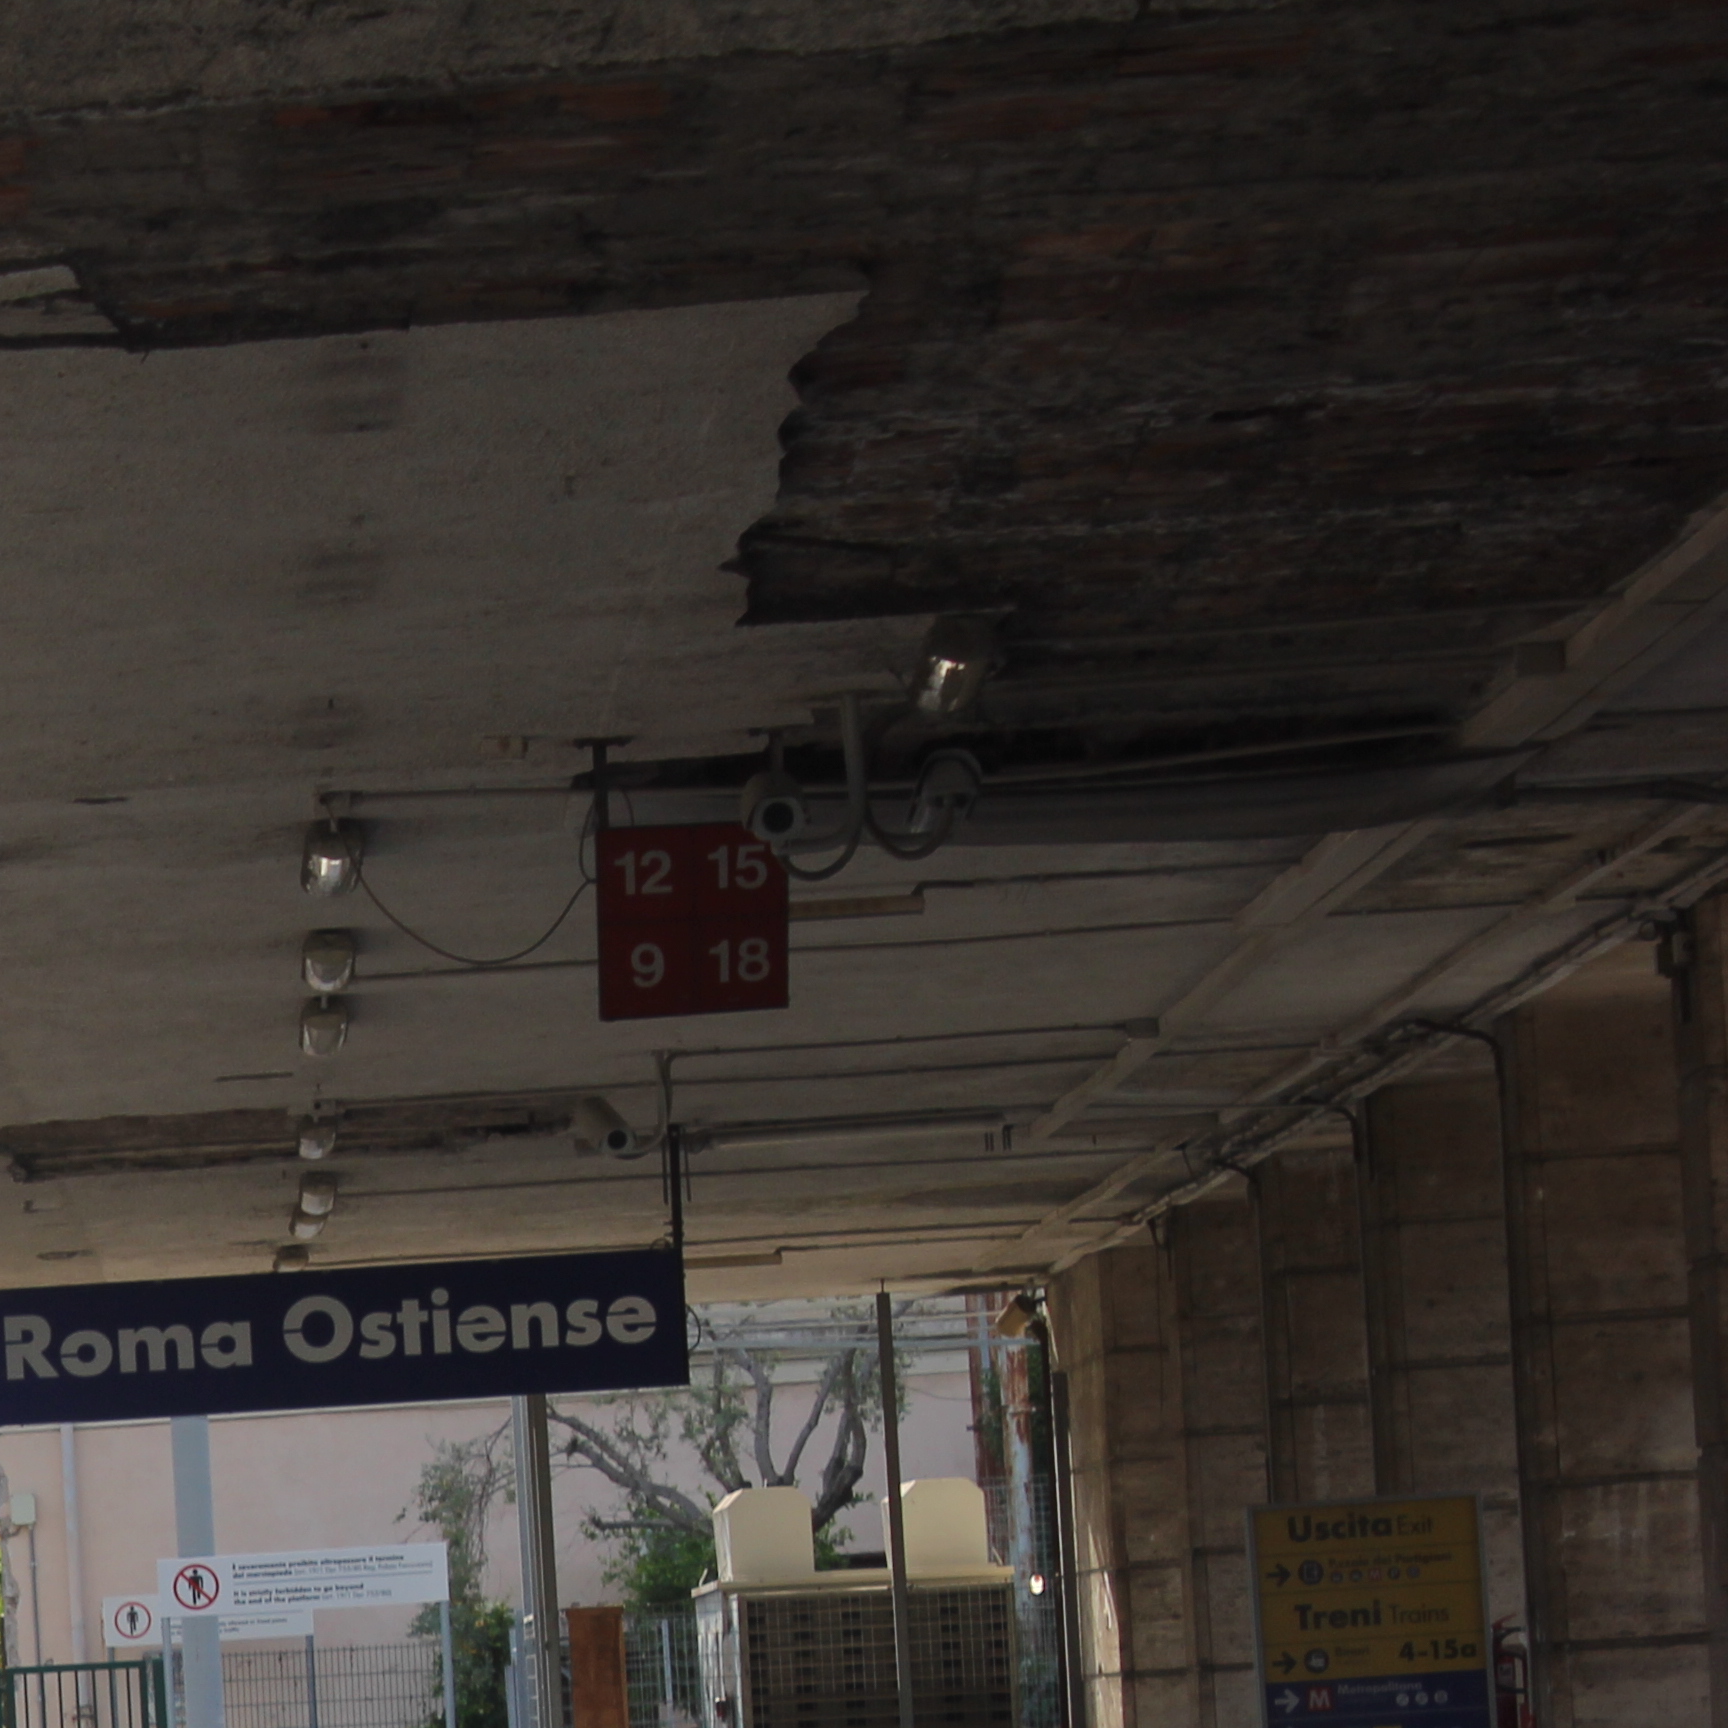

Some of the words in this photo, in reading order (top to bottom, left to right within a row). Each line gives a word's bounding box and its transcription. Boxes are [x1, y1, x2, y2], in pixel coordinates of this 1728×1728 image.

[613, 849, 674, 896] 12
[706, 843, 769, 890] 15
[630, 942, 666, 988] 9
[708, 937, 772, 983] 18
[2, 1314, 254, 1381] Roma
[282, 1288, 659, 1363] Ostiense
[1287, 1511, 1393, 1543] Uscita
[1397, 1513, 1433, 1535] Exit
[1294, 1598, 1382, 1631] Treni
[1389, 1602, 1450, 1624] Trains
[1399, 1638, 1477, 1661] 4-15a
[1309, 1689, 1330, 1709] M
[1337, 1681, 1423, 1695] Metropolitana
